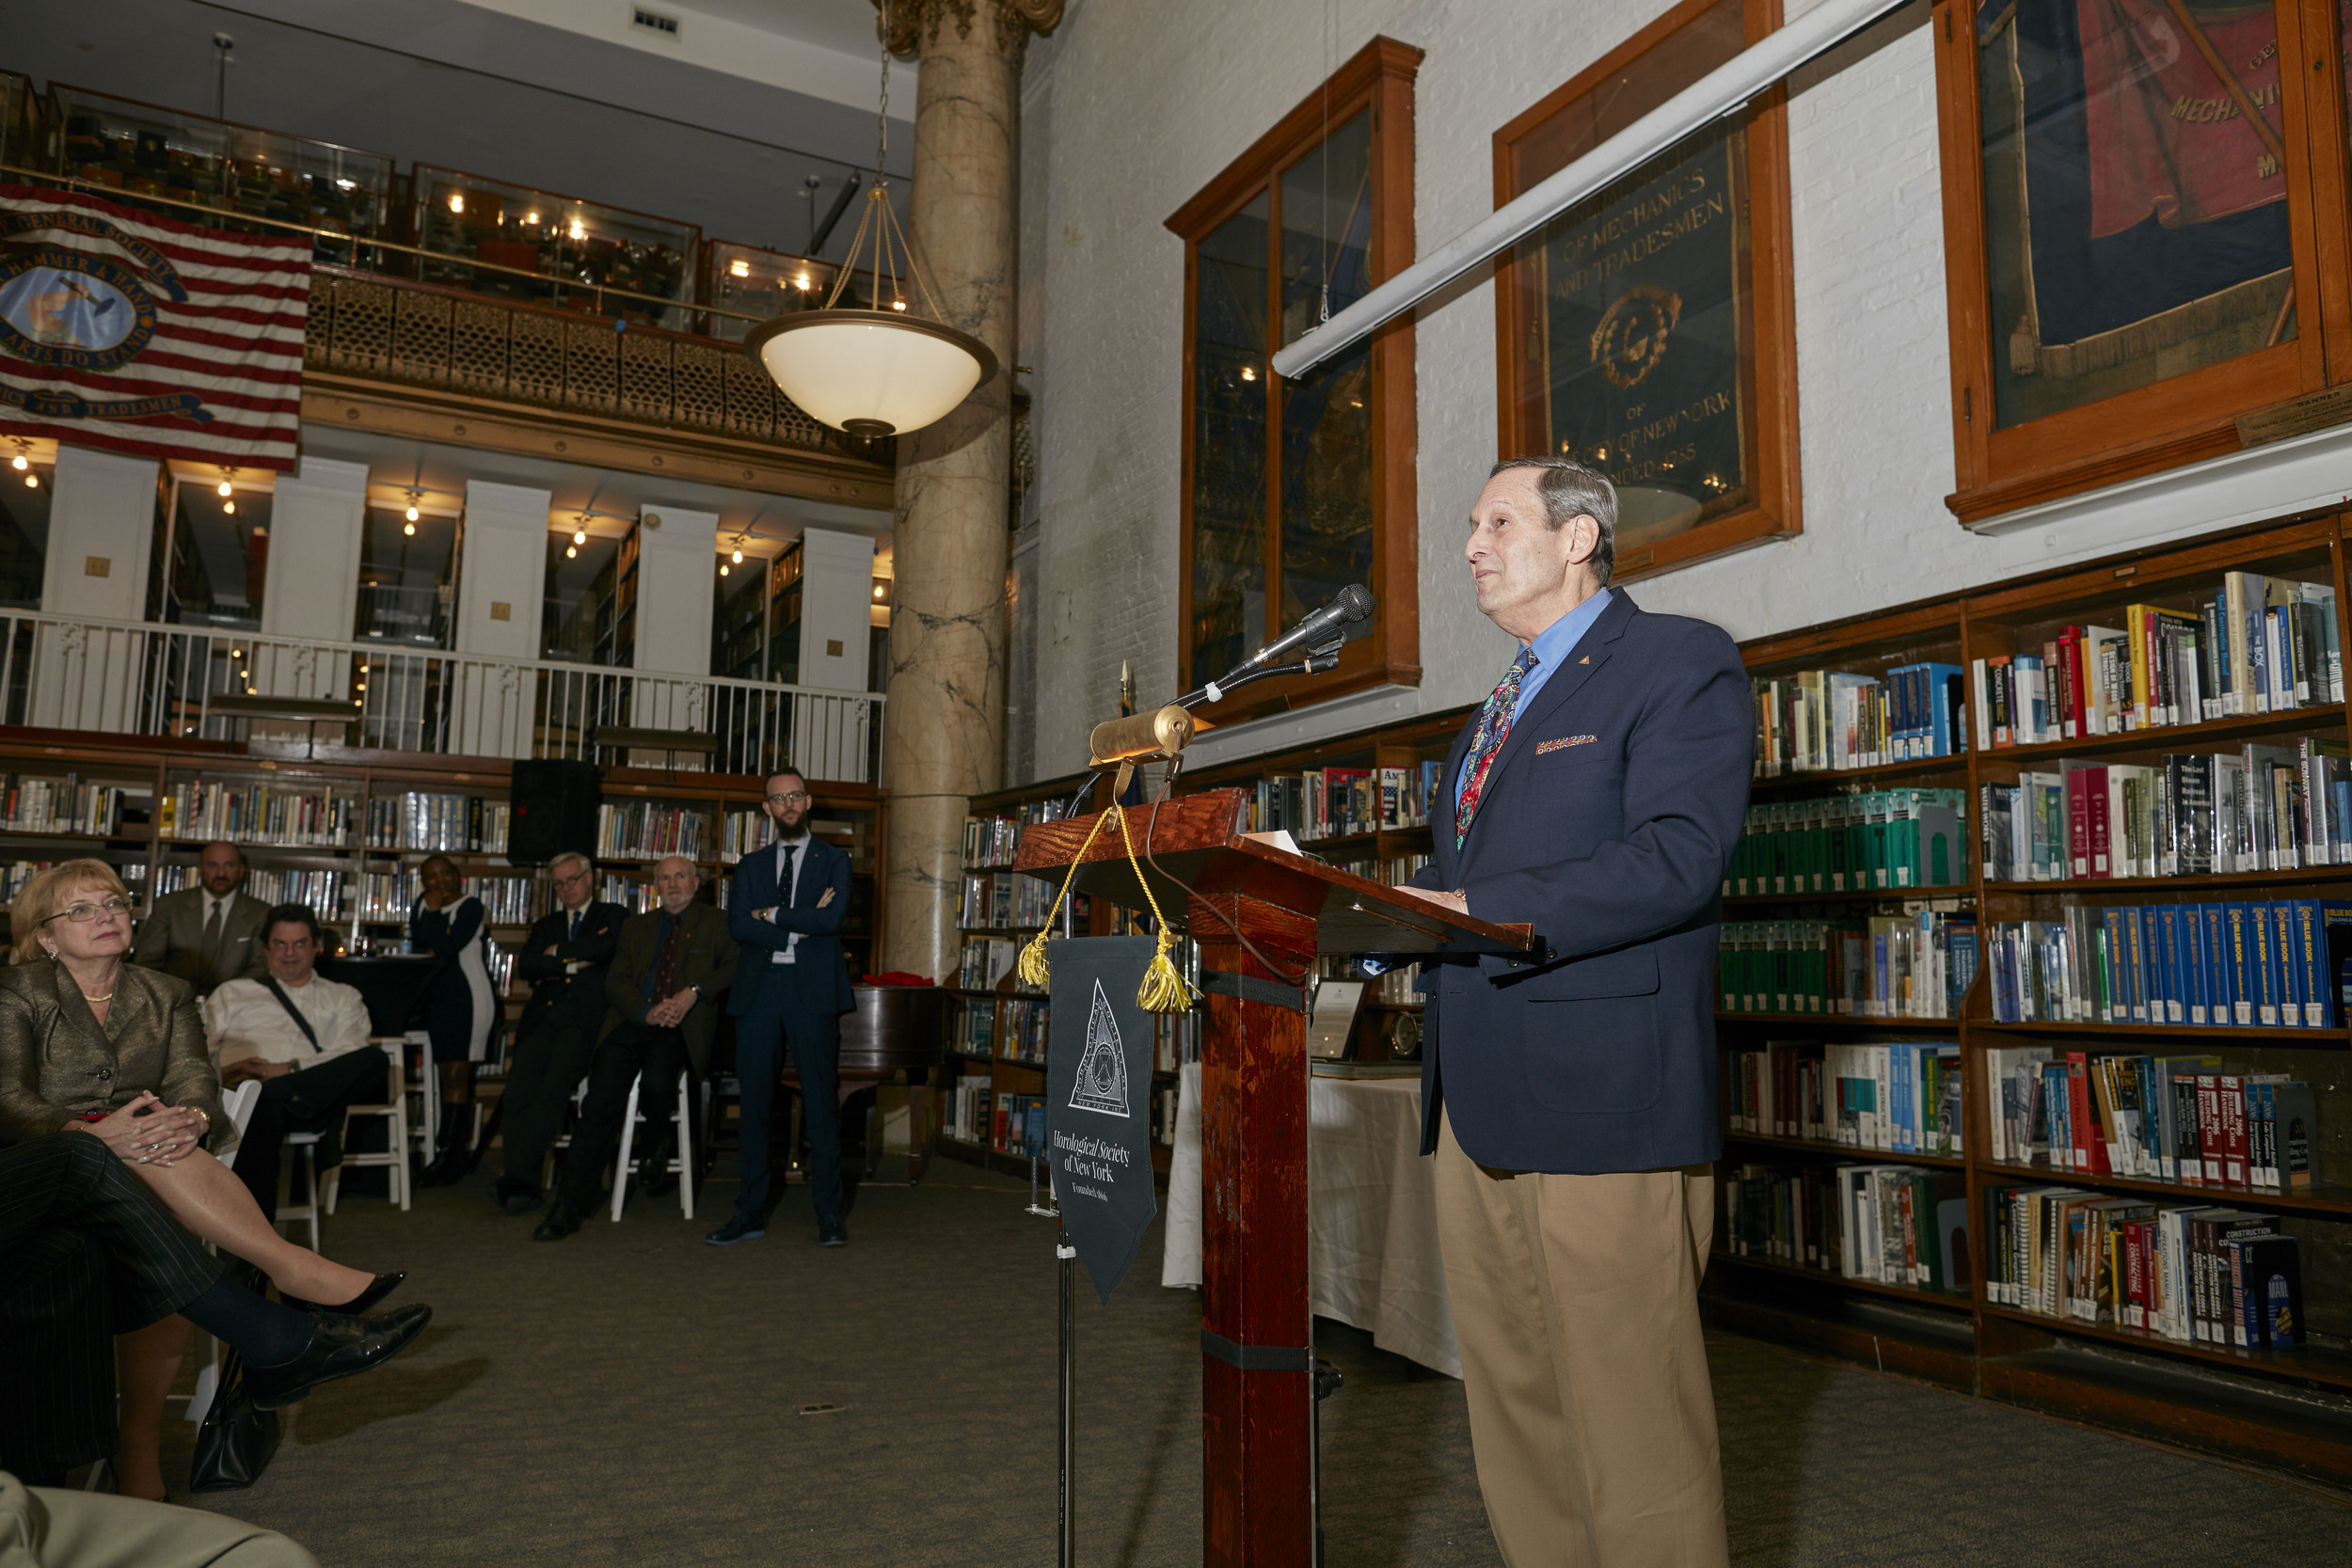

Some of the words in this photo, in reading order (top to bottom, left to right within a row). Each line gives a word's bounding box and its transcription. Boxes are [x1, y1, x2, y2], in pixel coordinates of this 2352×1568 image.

[1564, 235, 1588, 263] OF
[1593, 167, 1706, 251] MECHANICS
[19, 212, 103, 234] GENERAL
[104, 223, 173, 278] SOCIETY
[1556, 269, 1588, 301] AND
[1594, 191, 1724, 283] TRADESMEN
[8, 251, 88, 276] HAMMER
[95, 265, 107, 277] &
[112, 272, 151, 314] HAND
[6, 333, 53, 363] ARTS
[60, 350, 88, 366] DO
[98, 328, 150, 367] STAND
[36, 402, 72, 415] AND
[86, 397, 182, 416] TRADESMEN
[1626, 402, 1646, 420] OF
[2296, 391, 2342, 408] BANNER
[1618, 428, 1641, 452] OF
[1643, 413, 1679, 445] NEW
[1611, 459, 1655, 485] NDED
[2216, 594, 2226, 610] Steel
[2217, 612, 2229, 651] Construction
[2220, 652, 2230, 676] Manual
[2254, 646, 2265, 668] BOX
[2296, 635, 2305, 672] Waterworks
[2124, 661, 2133, 683] Wood
[1994, 668, 2006, 705] CONCRETE
[2244, 748, 2252, 774] metro
[2181, 787, 2206, 796] Railroad
[2188, 799, 2211, 807] America
[2234, 942, 2243, 963] BOOK
[2280, 942, 2289, 963] BOOK
[2073, 1079, 2083, 1145] CONSTRUCTION
[2220, 1090, 2229, 1131] HANDBOOK
[1054, 1130, 1100, 1157] Horological
[1098, 1141, 1130, 1168] Society
[2229, 1126, 2237, 1148] CODE
[1064, 1154, 1073, 1172] of
[1073, 1156, 1091, 1177] New
[1091, 1161, 1115, 1182] York
[1072, 1181, 1098, 1198] Founded
[2226, 1227, 2272, 1238] CONSTRUCTION
[2129, 1243, 2137, 1291] CONTRACTING
